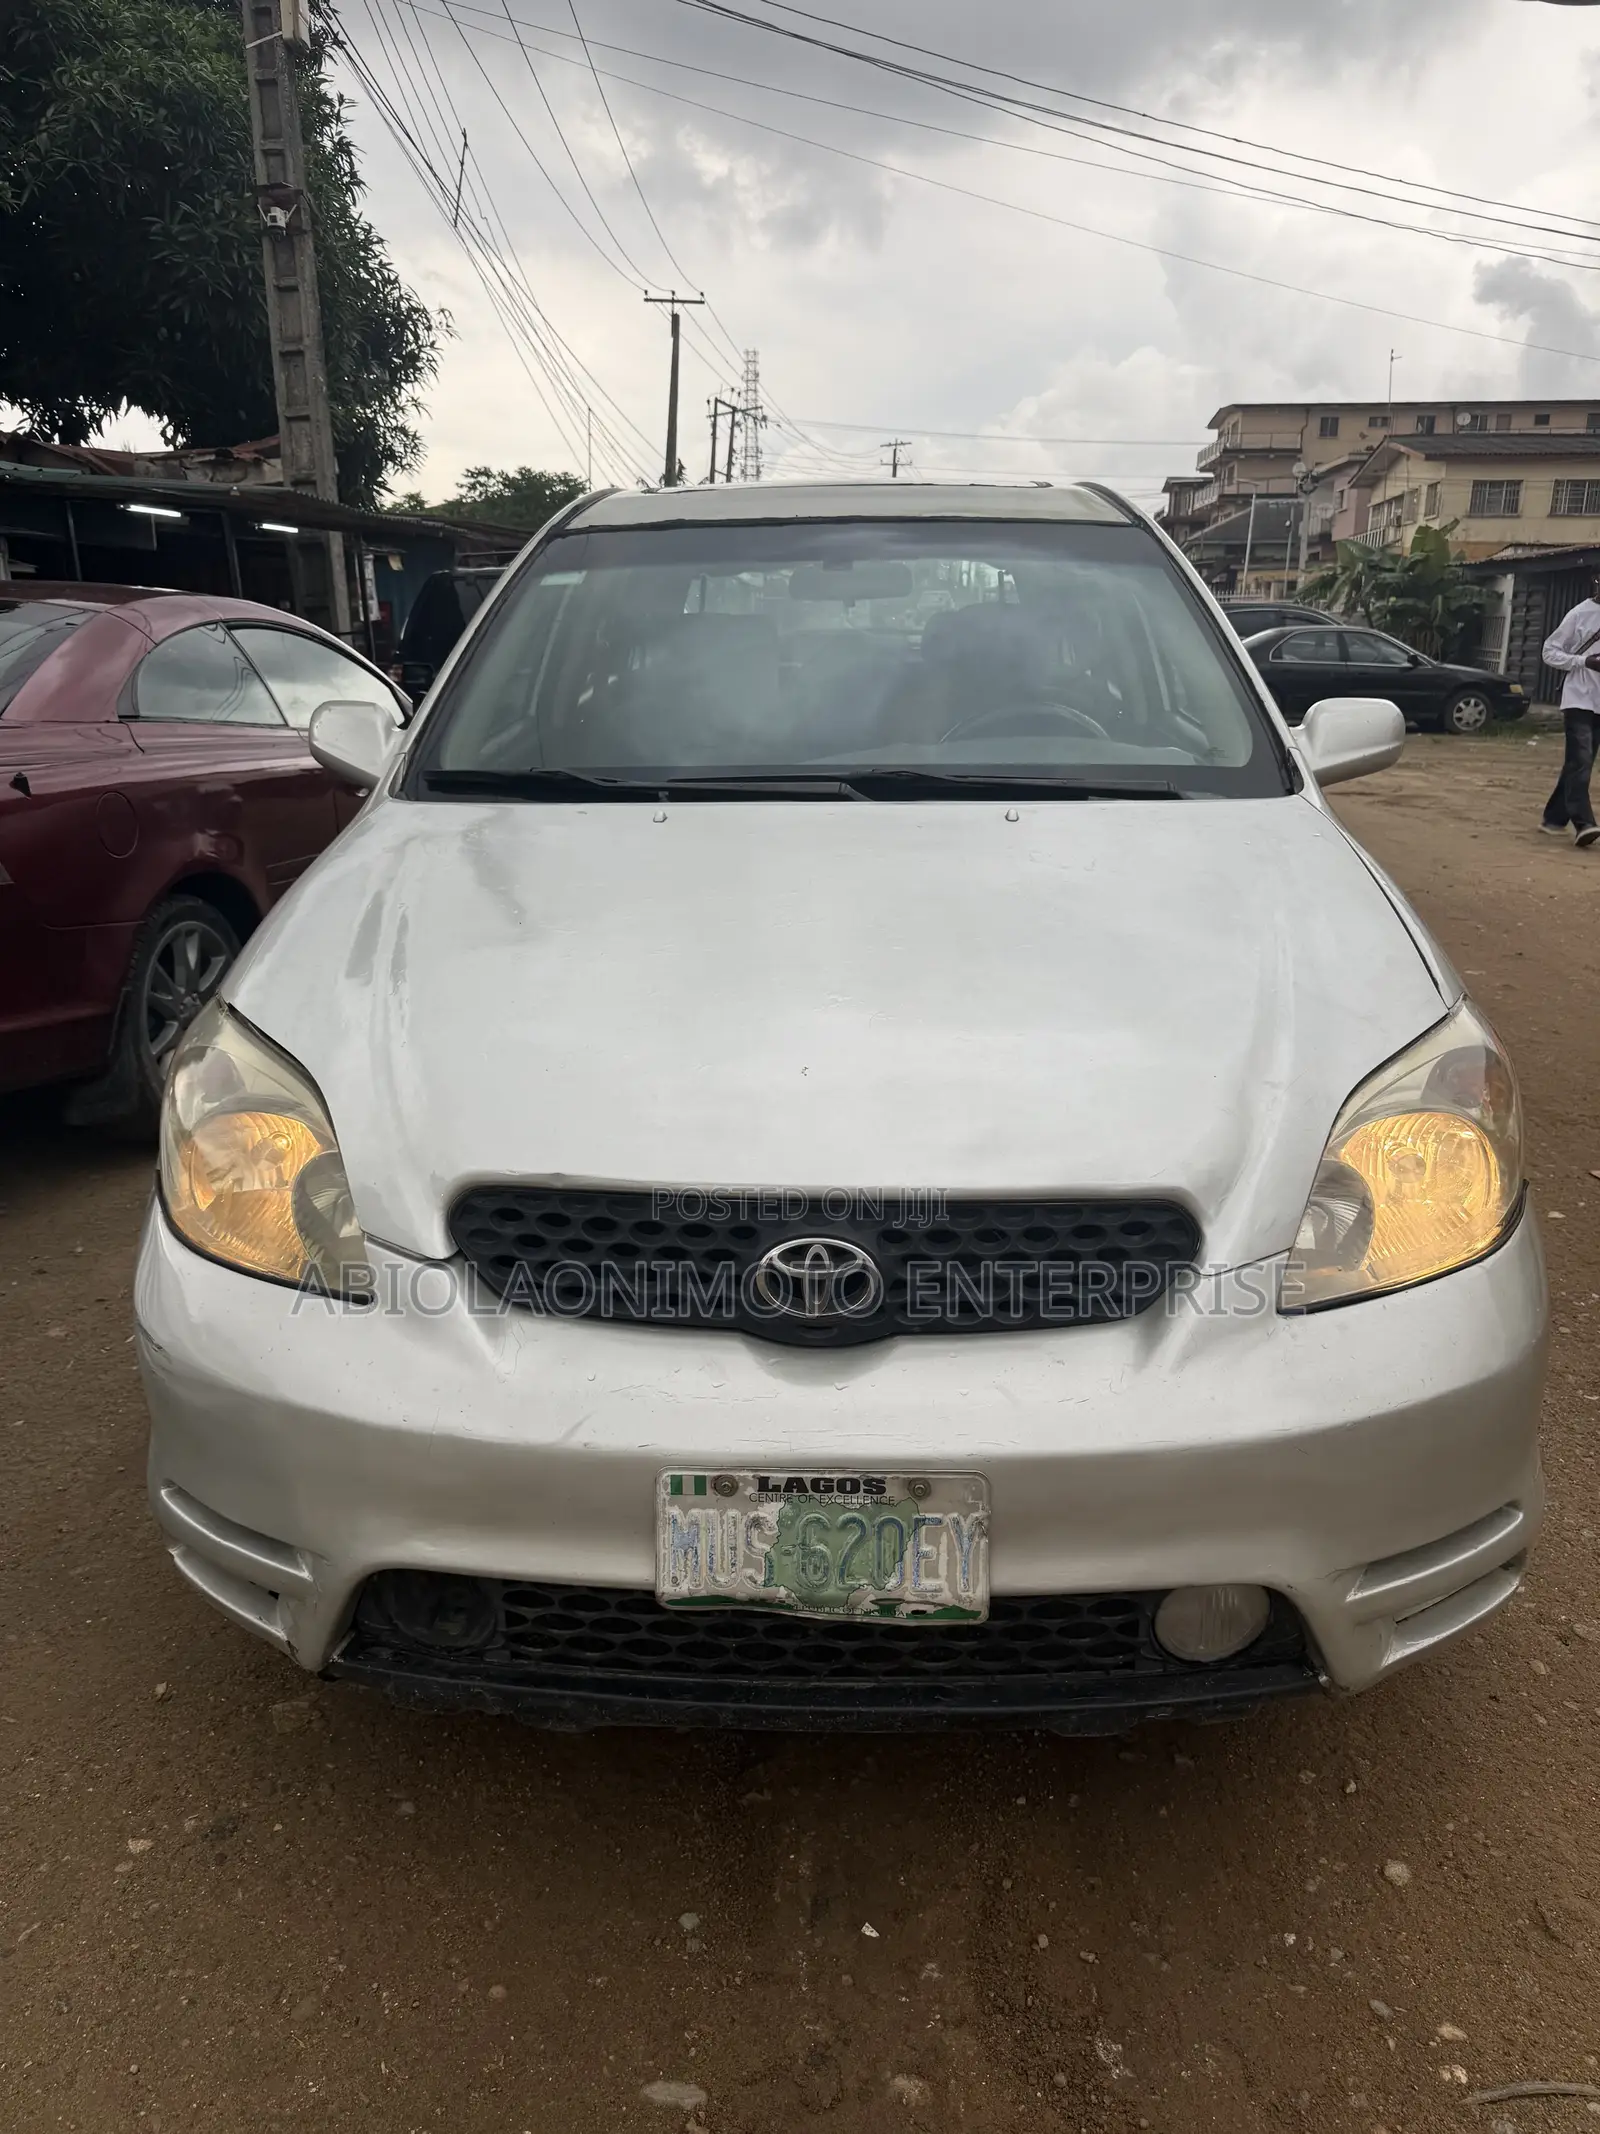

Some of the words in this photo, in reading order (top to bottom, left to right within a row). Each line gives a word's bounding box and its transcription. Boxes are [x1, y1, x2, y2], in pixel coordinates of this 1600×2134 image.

[757, 1476, 887, 1494] LAGOS
[749, 1493, 793, 1504] CENTRE
[798, 1494, 816, 1505] OF
[819, 1494, 895, 1506] EXCELLENCE
